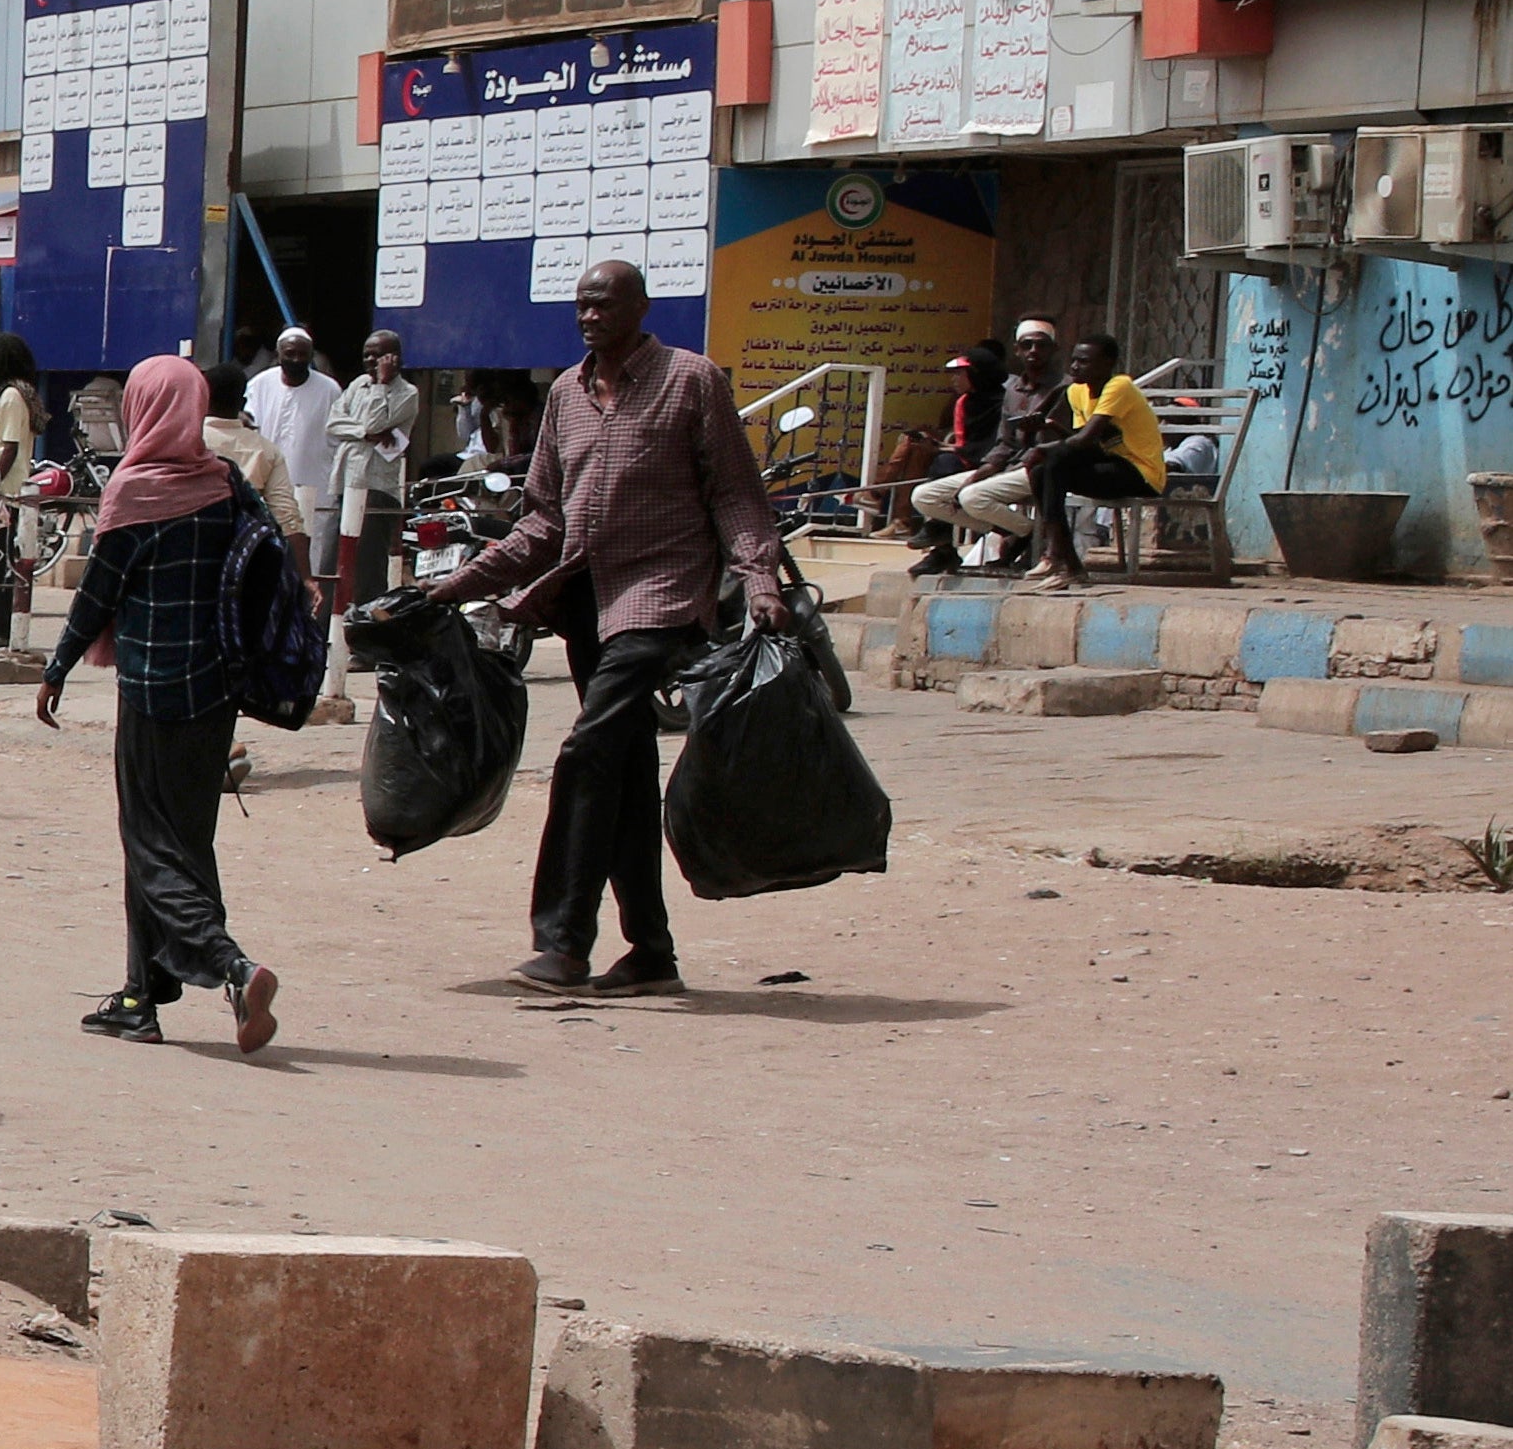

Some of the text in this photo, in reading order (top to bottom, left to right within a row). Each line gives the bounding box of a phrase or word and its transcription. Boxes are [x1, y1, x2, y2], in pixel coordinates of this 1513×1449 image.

[484, 44, 692, 104] مستشفى الجودة
[790, 251, 915, 265] Al Jawda Hospital
[856, 230, 915, 250] مستشفى
[1379, 290, 1435, 352] خان
